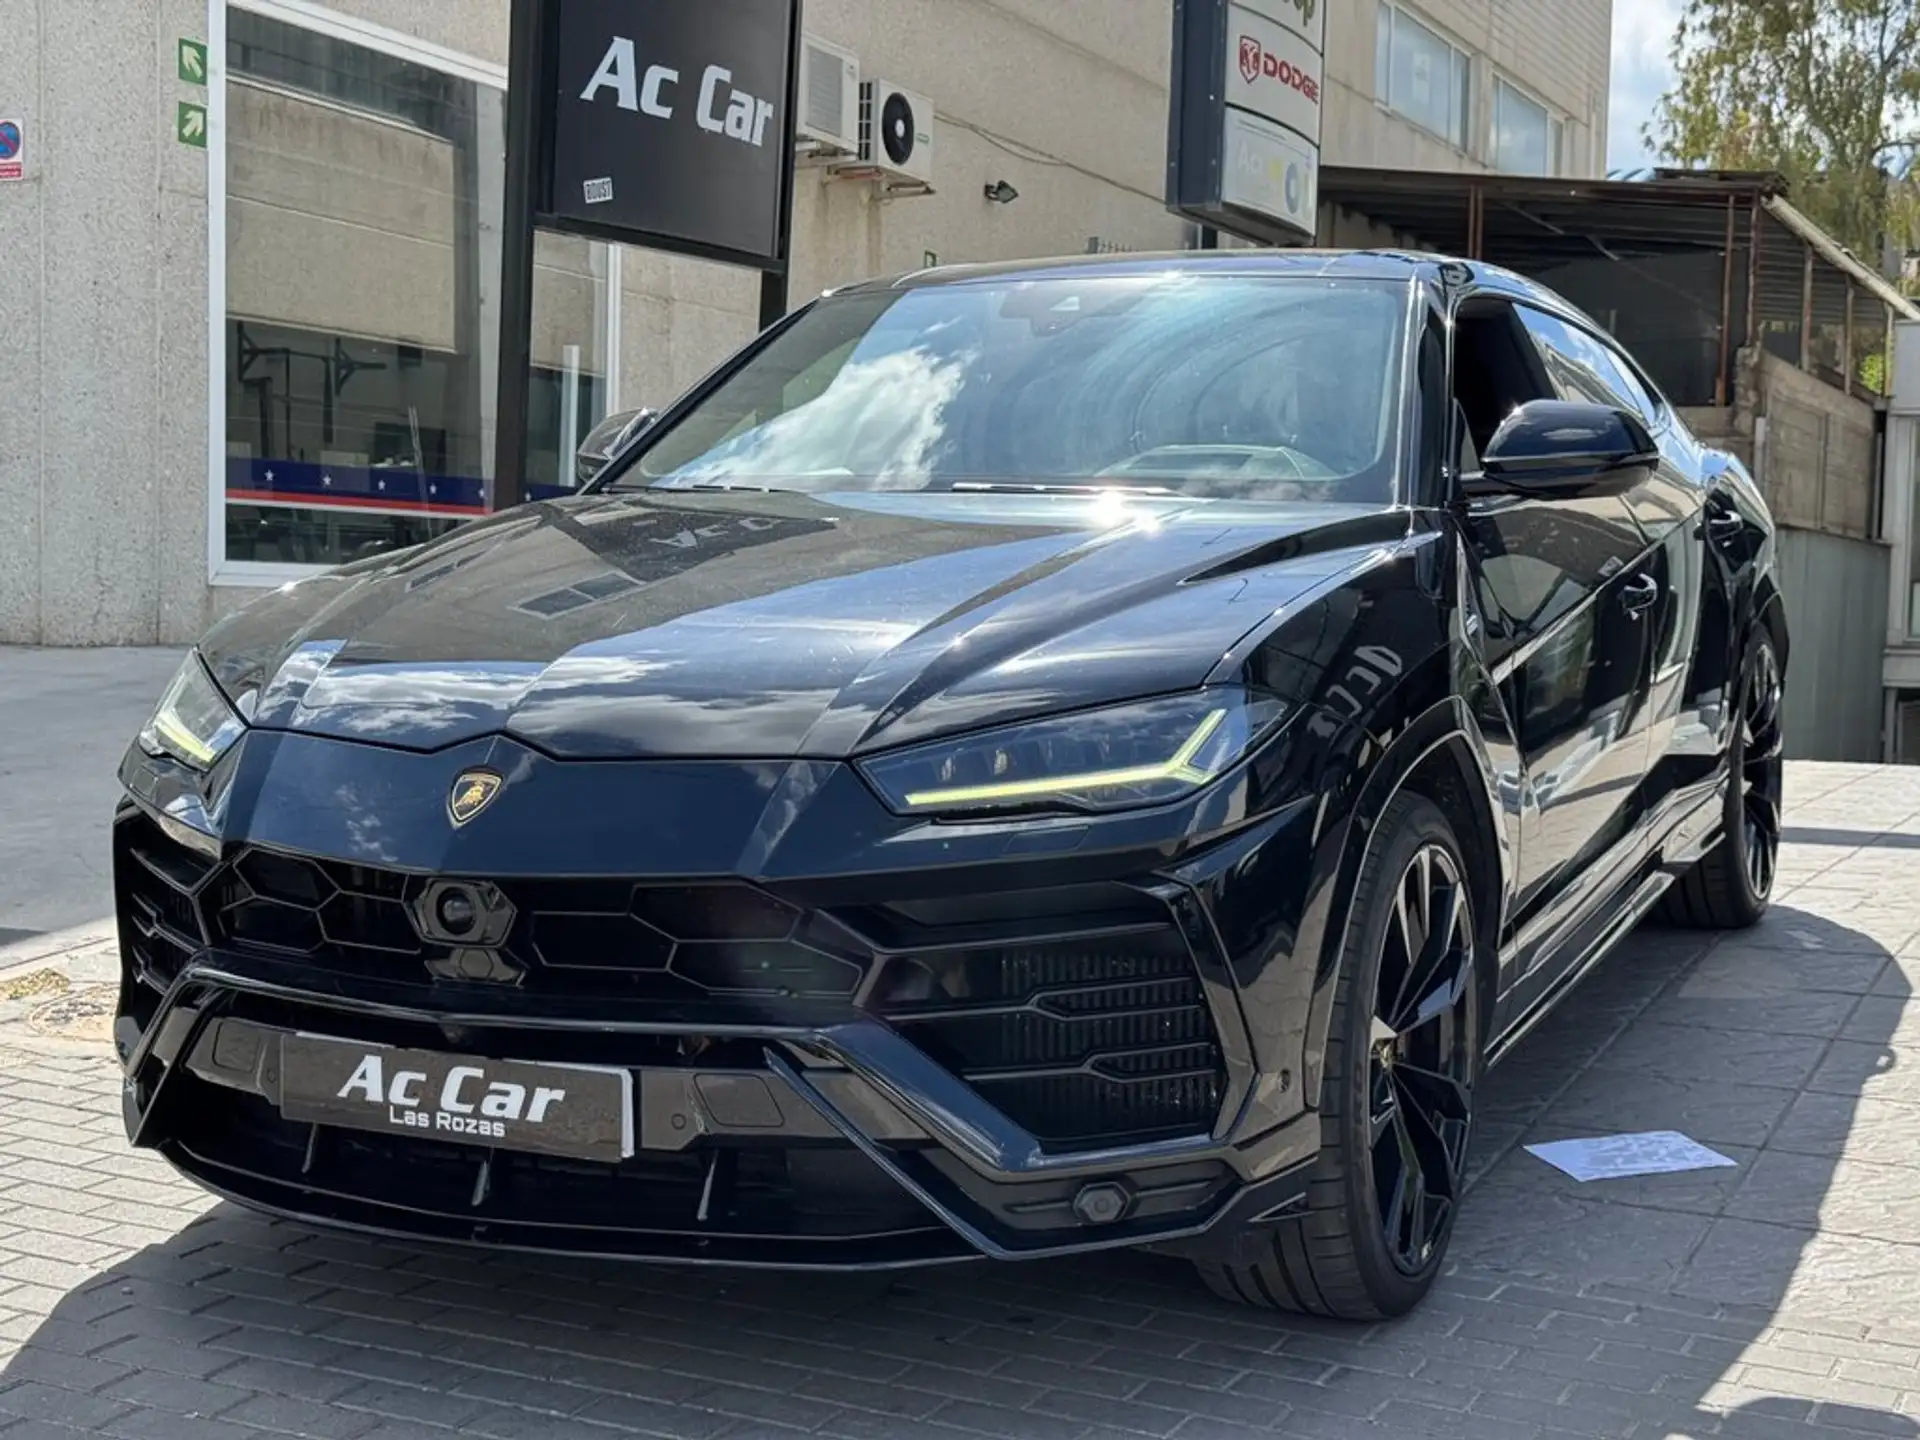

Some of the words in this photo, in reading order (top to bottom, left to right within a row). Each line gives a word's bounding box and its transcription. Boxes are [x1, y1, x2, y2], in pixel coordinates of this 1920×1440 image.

[580, 36, 679, 119] Ac
[696, 64, 774, 147] Car
[1263, 52, 1319, 104] DODGE
[336, 1054, 427, 1107] Ac
[440, 1066, 565, 1122] Car
[389, 1105, 429, 1128] Las
[436, 1112, 506, 1137] Rozas
